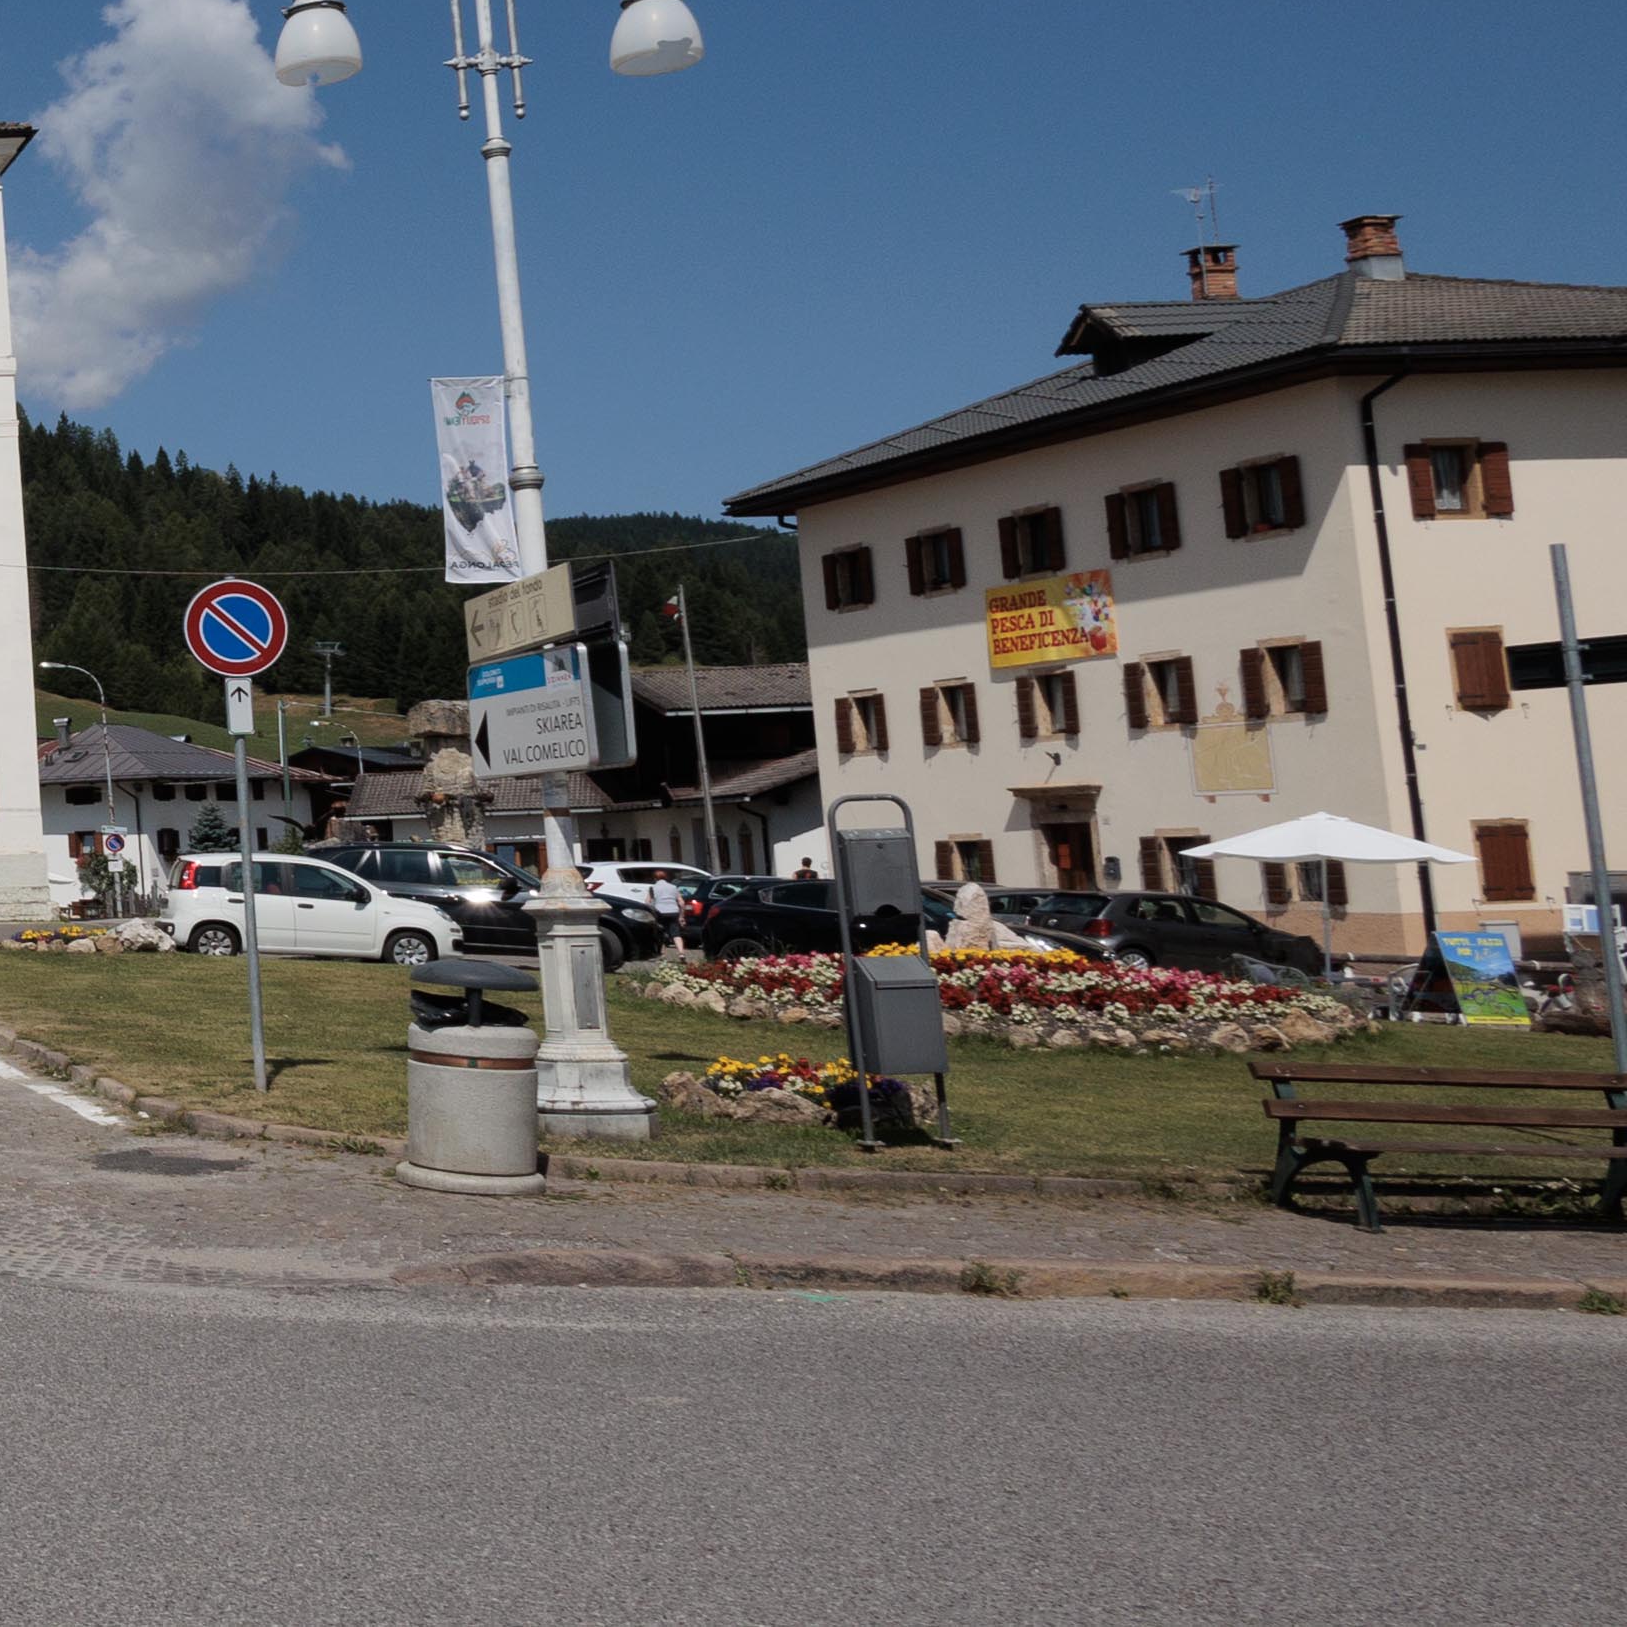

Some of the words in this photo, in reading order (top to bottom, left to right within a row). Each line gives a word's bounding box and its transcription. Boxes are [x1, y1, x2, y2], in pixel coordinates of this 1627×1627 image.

[488, 588, 508, 609] stadio
[509, 584, 521, 600] del
[522, 579, 543, 596] fondo
[989, 589, 1047, 614] GRANDE
[990, 613, 1036, 634] PESCA
[1039, 609, 1055, 628] DI
[993, 626, 1090, 655] BENEFICENZA
[536, 712, 584, 735] SKIAREA
[503, 745, 524, 765] VAL
[527, 739, 586, 763] COMELICO
